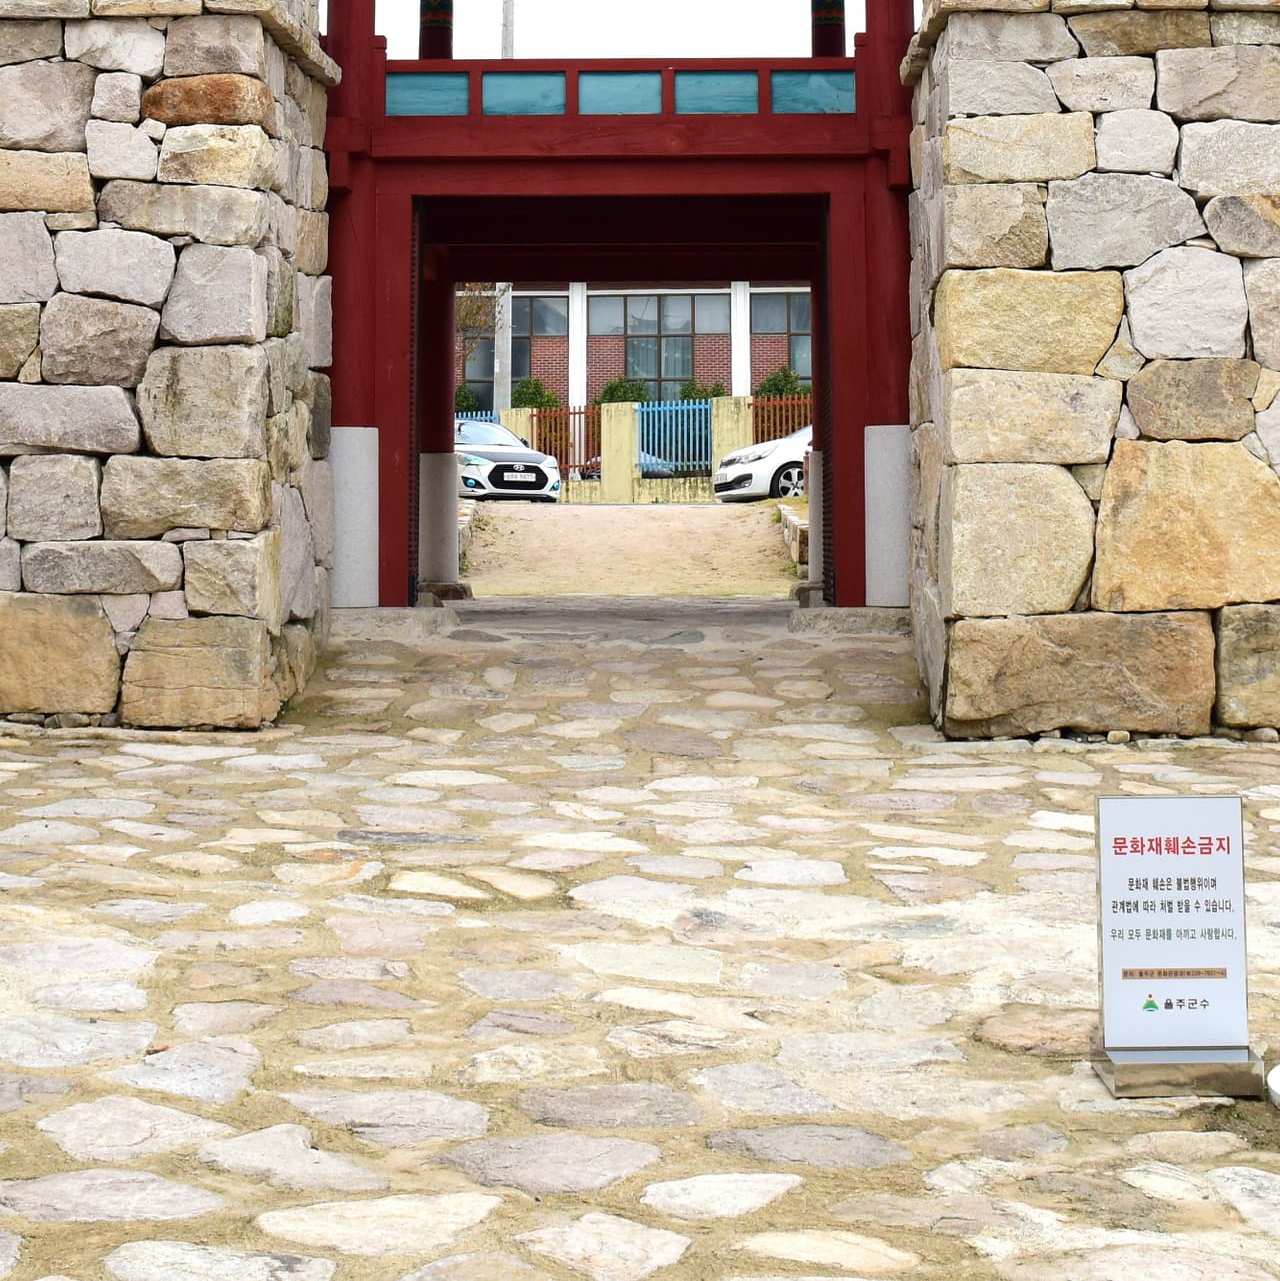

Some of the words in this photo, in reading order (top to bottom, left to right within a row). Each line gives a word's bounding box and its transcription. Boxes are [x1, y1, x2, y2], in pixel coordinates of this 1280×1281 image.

[1111, 835, 1231, 856] 문화재훼손금지
[1127, 877, 1149, 891] 문화재
[1152, 877, 1173, 891] 훼손은
[1176, 877, 1217, 891] 불법행위이며
[1111, 899, 1139, 913] 관계법에
[1142, 899, 1157, 913] 따라
[1160, 899, 1174, 913] 처벌
[1177, 899, 1191, 913] 받을
[1194, 899, 1201, 913] 수
[1204, 898, 1235, 913] 있습니다.
[1110, 928, 1124, 941] 우리
[1127, 928, 1142, 940] 모두
[1145, 928, 1173, 941] 문화재를
[1176, 927, 1196, 940] 아끼고
[1200, 927, 1237, 940] 사랑합시다.
